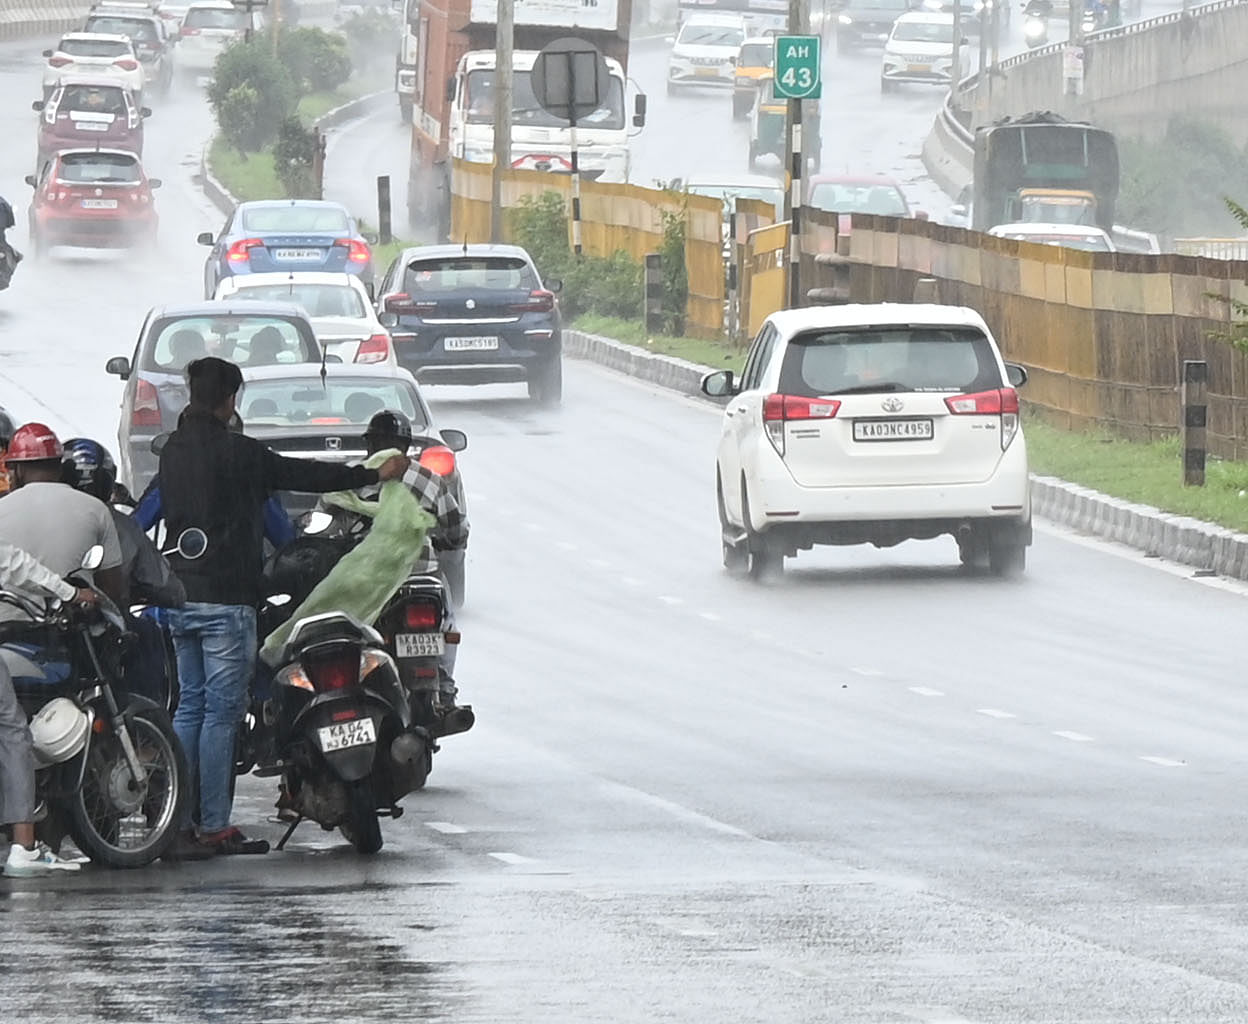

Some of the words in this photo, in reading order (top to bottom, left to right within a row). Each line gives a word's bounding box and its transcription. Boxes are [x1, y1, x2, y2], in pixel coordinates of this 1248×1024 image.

[785, 45, 809, 58] AH
[781, 67, 812, 88] 43
[863, 423, 930, 436] KA03NC4959
